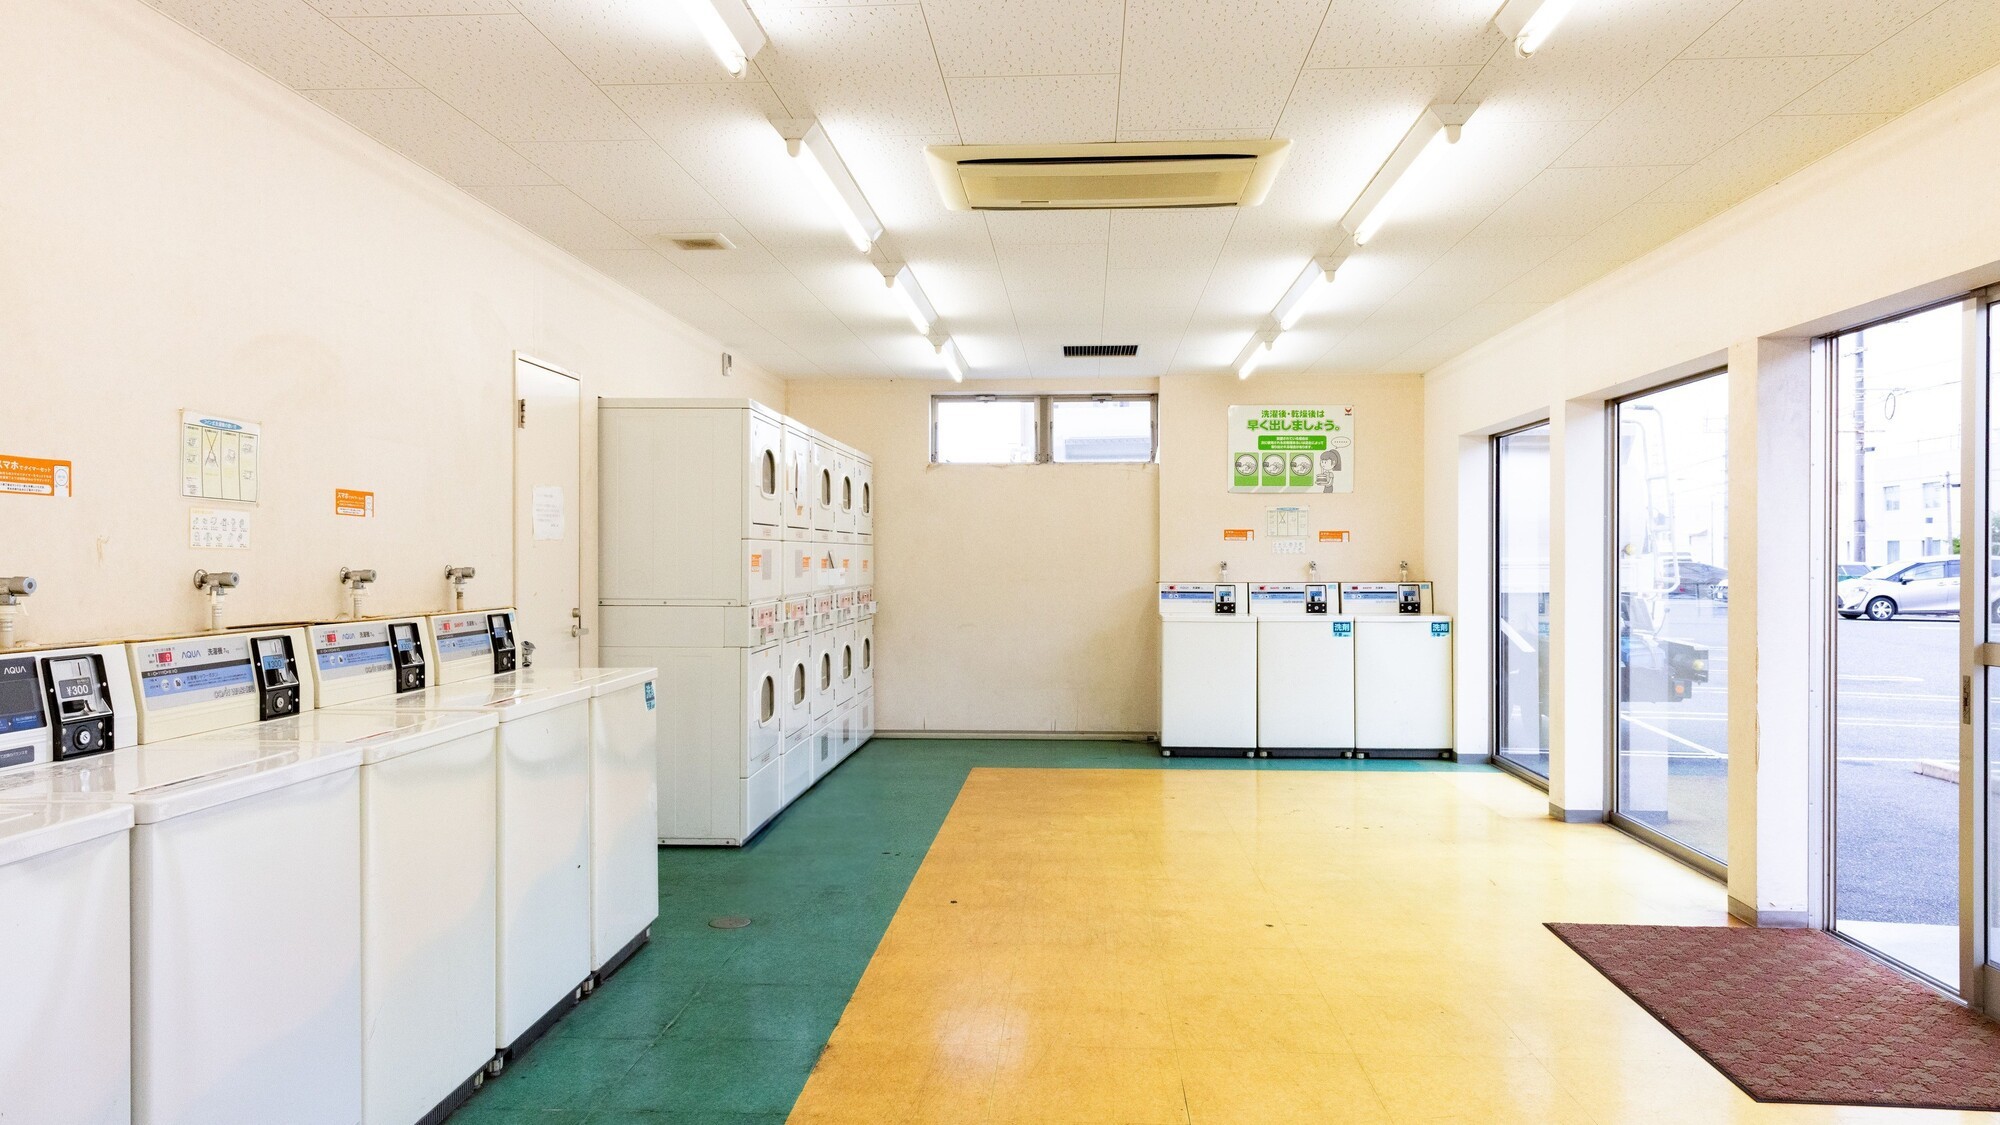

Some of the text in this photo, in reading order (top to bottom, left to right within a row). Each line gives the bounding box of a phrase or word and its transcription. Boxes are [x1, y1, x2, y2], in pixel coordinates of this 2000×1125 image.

[1261, 409, 1325, 419] 洗濯後・乾燥後は
[1247, 419, 1341, 432] 早く出しましょう。
[1334, 623, 1350, 632] 洗剤
[1432, 623, 1448, 632] 洗剤
[181, 649, 201, 660] AQUA
[207, 647, 223, 656] 洗濯機
[267, 659, 282, 669] ¥300
[3, 665, 27, 675] AQUA
[65, 684, 89, 697] ¥300
